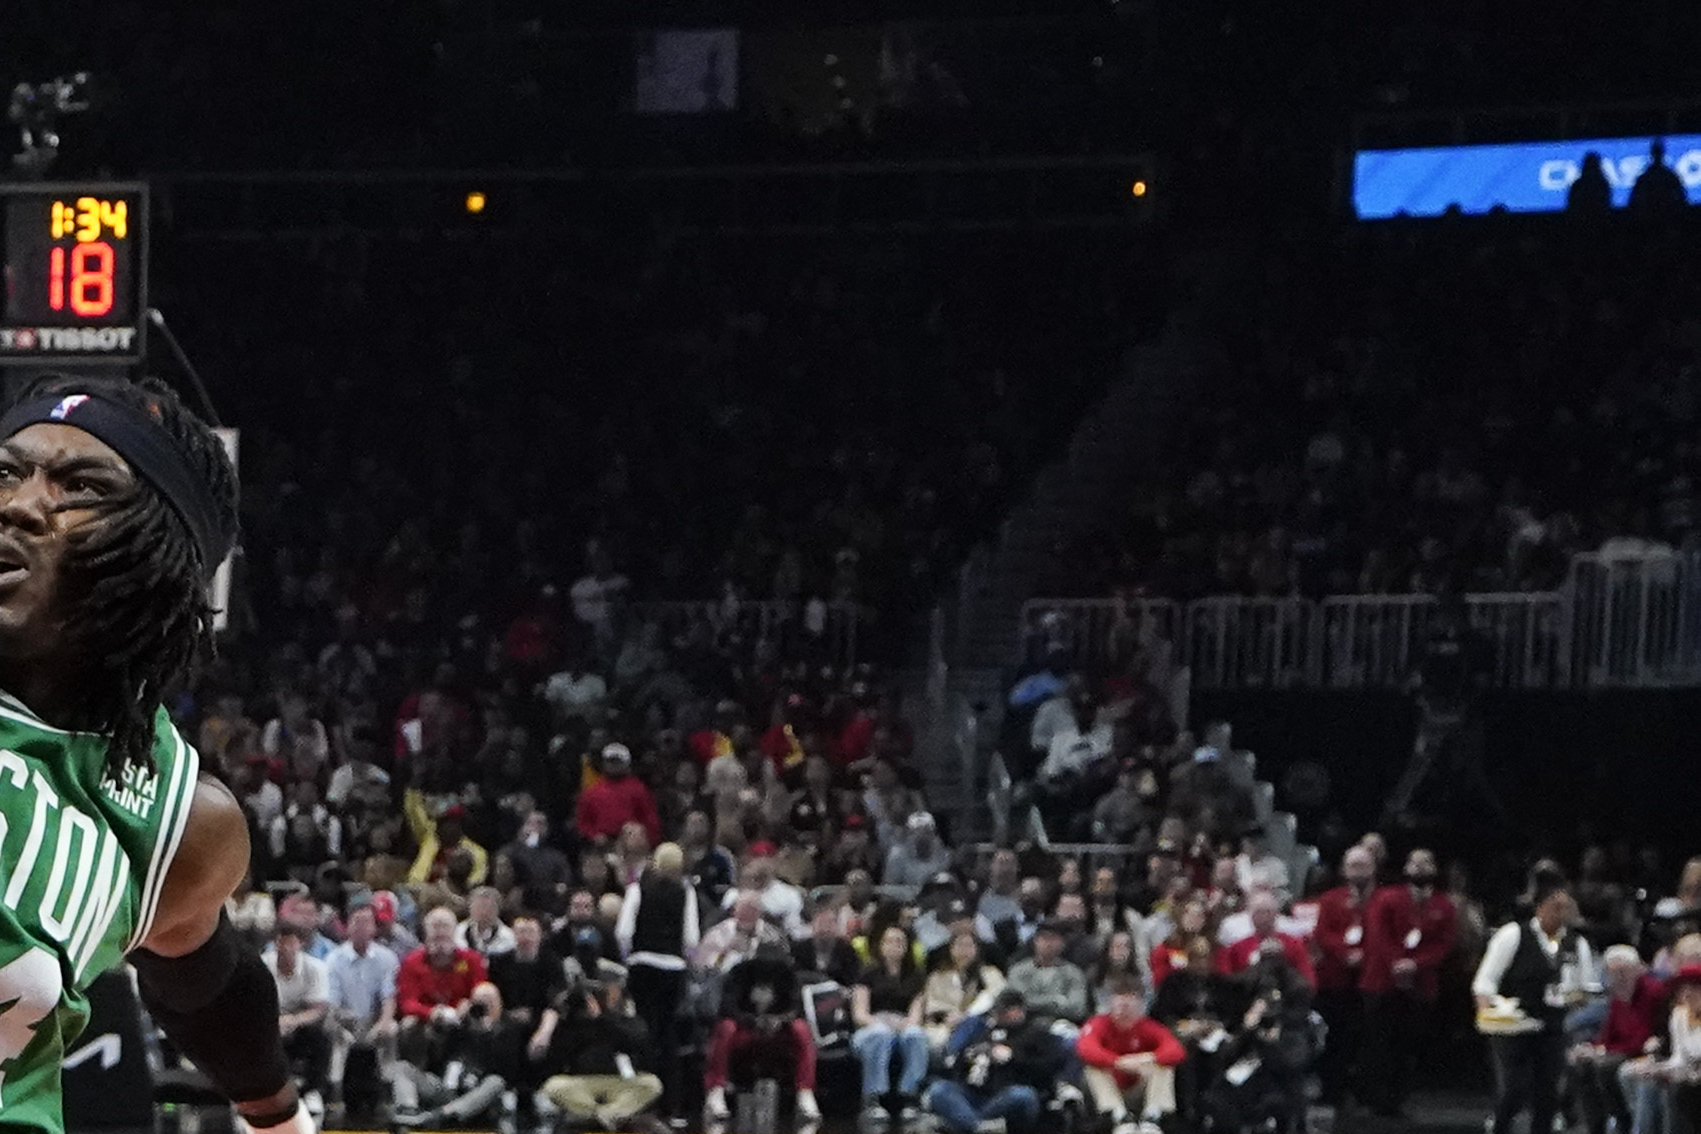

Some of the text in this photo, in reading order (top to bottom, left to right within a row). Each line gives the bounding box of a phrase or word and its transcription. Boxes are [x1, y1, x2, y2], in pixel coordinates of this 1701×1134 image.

[51, 197, 127, 242] 1:34
[49, 241, 114, 316] 18
[36, 326, 136, 350] TISSOT
